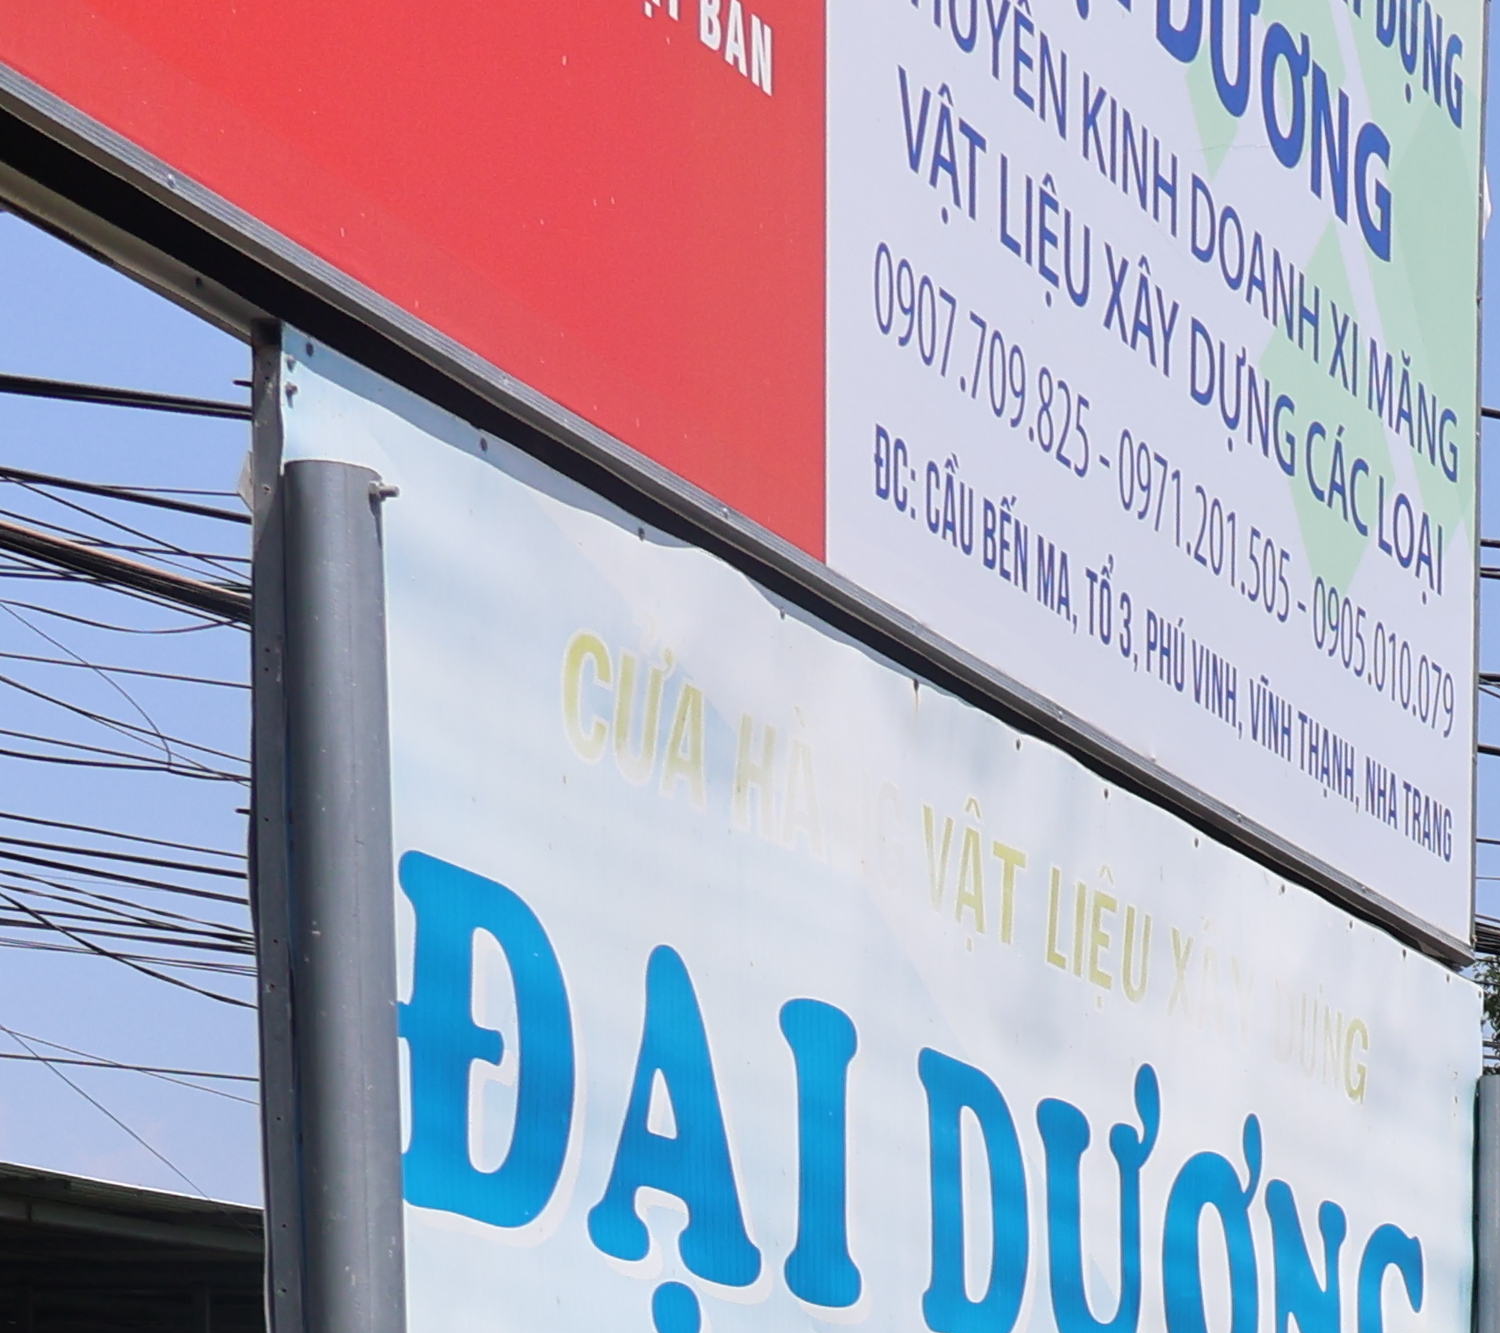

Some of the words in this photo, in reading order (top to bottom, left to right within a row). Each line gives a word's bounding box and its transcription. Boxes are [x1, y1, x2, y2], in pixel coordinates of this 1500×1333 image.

[898, 65, 986, 224] VẬT
[1001, 153, 1091, 307] LIỆU
[1103, 240, 1180, 378] XÂY
[1191, 317, 1295, 478] DỰNG
[1305, 421, 1369, 538] CÁC
[1378, 475, 1443, 604] LOẠI
[911, 0, 1068, 140] UYÊN
[1082, 71, 1178, 238] KINH
[1192, 171, 1320, 364] DOANH
[1330, 300, 1358, 398] XI
[1368, 339, 1458, 483] MĂNG
[874, 241, 1090, 478] 0907.709.825
[1118, 428, 1291, 624] 0971.201.505
[1312, 576, 1456, 739] 0905.010.079
[874, 423, 917, 520] ĐC:
[926, 451, 973, 557] CẦU
[983, 495, 1028, 594] BẾN
[1036, 533, 1078, 636] MA,
[1085, 555, 1114, 647] TỔ
[1118, 592, 1139, 672] 3,
[1145, 609, 1186, 695] PHÚ
[1191, 637, 1243, 740] VINH,
[1248, 677, 1292, 763] VĨNH
[1298, 710, 1360, 814] THẠNH,
[1364, 760, 1399, 832] NHA
[1402, 780, 1453, 864] TRANG
[921, 797, 1026, 953] VẬT
[1046, 865, 1153, 1007] LIỆU
